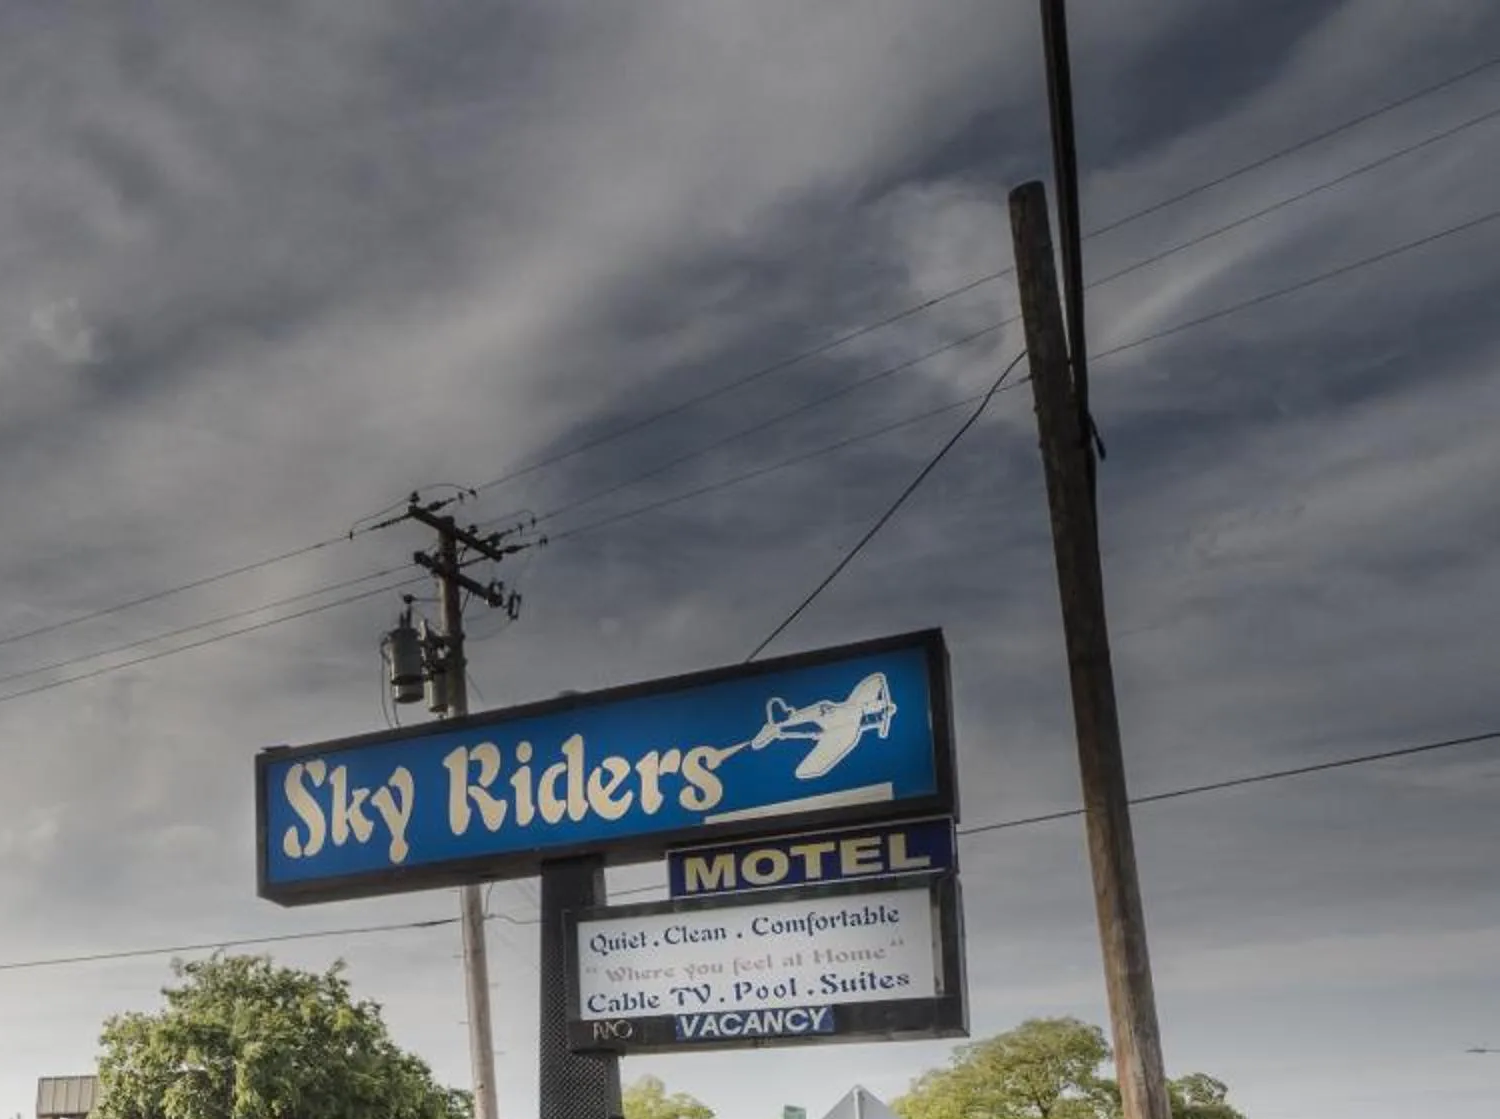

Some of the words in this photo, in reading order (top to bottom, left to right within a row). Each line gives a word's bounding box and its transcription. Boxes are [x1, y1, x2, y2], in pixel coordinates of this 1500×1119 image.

[283, 757, 414, 864] Sky
[442, 733, 746, 836] Riders
[684, 832, 932, 895] MOTEL
[590, 931, 647, 956] Quiet
[664, 925, 727, 945] Clean
[751, 905, 900, 936] Comfortable
[683, 962, 724, 981] you
[732, 954, 773, 976] feel
[782, 953, 803, 967] at
[587, 991, 661, 1013] Cable
[669, 983, 712, 1007] TV
[733, 977, 798, 1001] Pool
[819, 970, 911, 995] Suites
[679, 1007, 830, 1040] VACANCY
